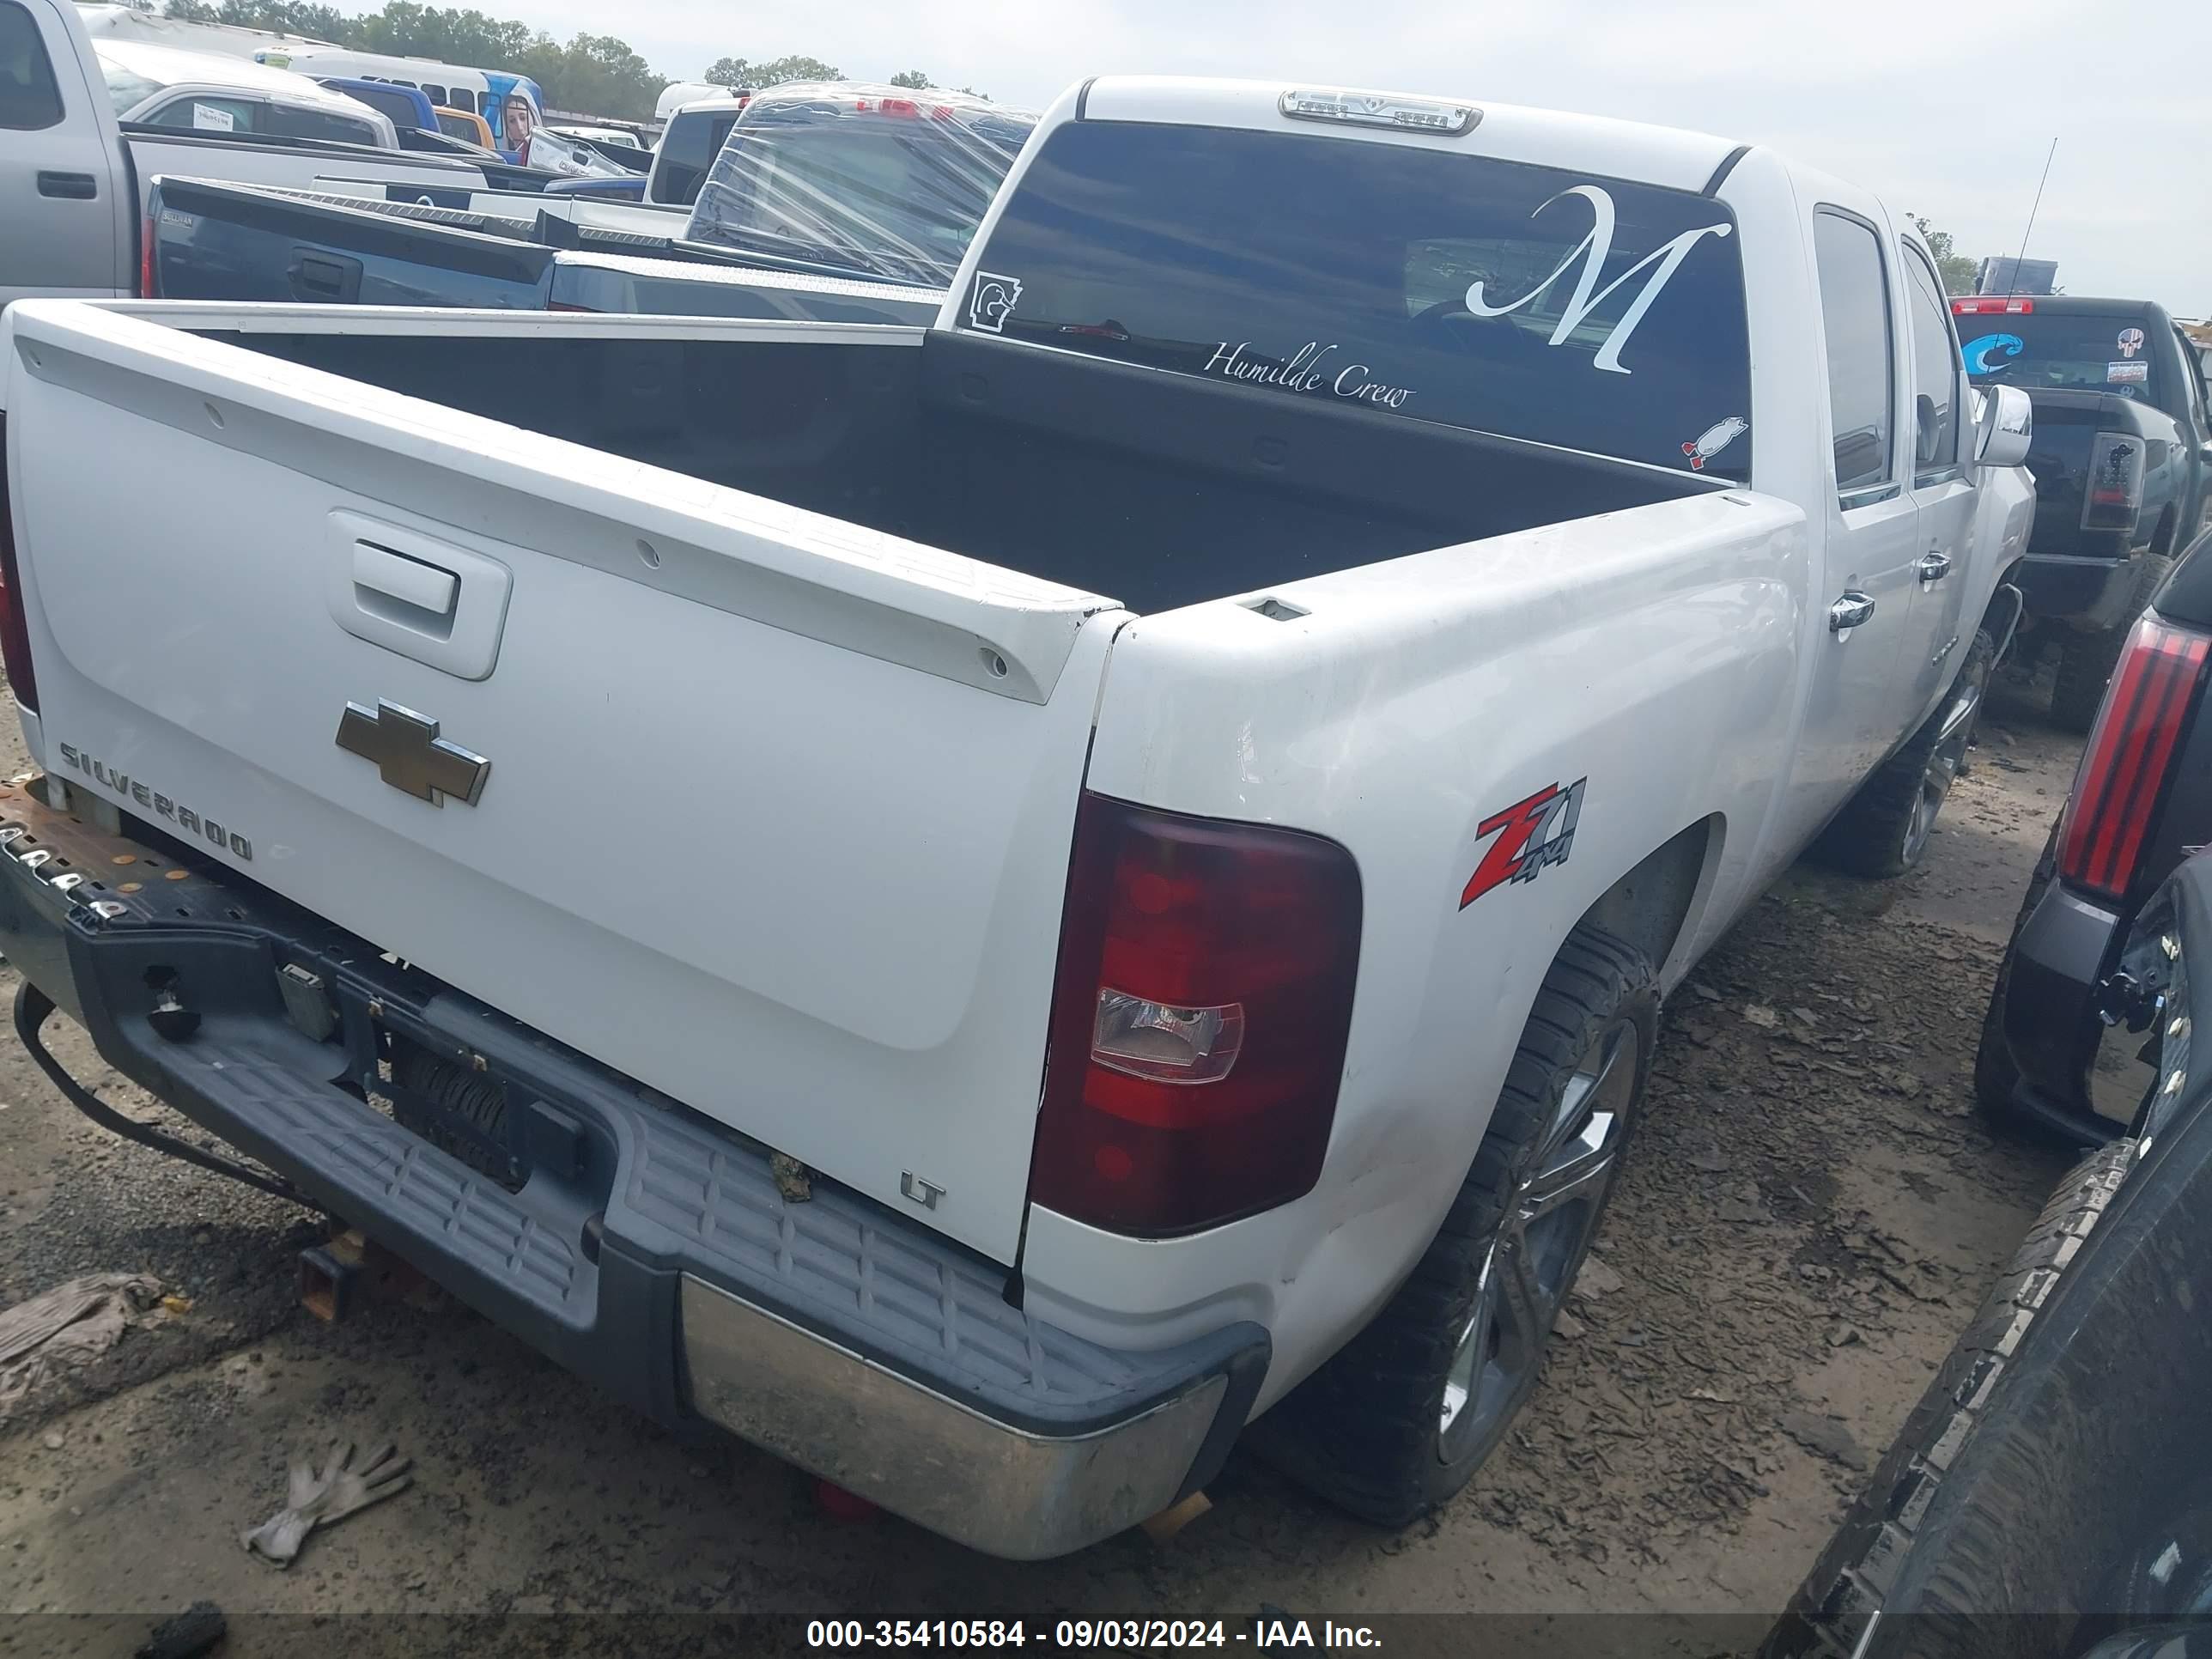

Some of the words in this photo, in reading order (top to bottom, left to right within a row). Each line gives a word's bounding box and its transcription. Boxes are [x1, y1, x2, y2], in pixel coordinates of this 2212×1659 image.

[1465, 185, 1732, 375] M
[1203, 341, 1338, 392] Humilde
[1334, 364, 1418, 408] Crew
[60, 742, 252, 860] SILVERADO
[1458, 775, 1588, 913] Z71
[900, 1169, 946, 1211] LT
